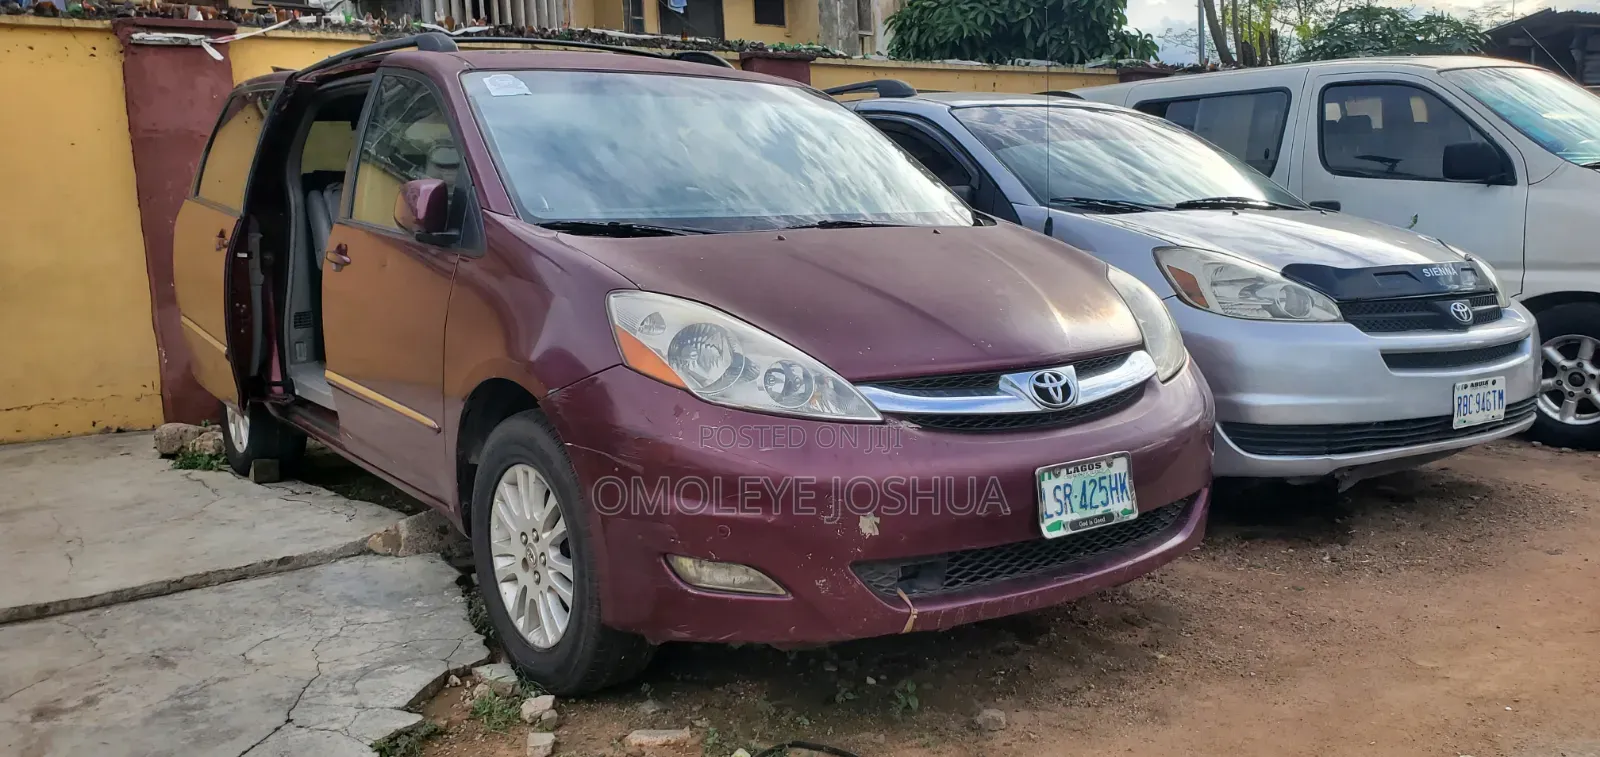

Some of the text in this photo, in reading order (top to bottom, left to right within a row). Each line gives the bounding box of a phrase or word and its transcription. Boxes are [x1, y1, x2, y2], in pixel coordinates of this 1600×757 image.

[1422, 267, 1458, 277] SIENNA
[1065, 462, 1102, 475] LAGOS
[1078, 519, 1089, 528] God
[1094, 516, 1106, 525] Good
